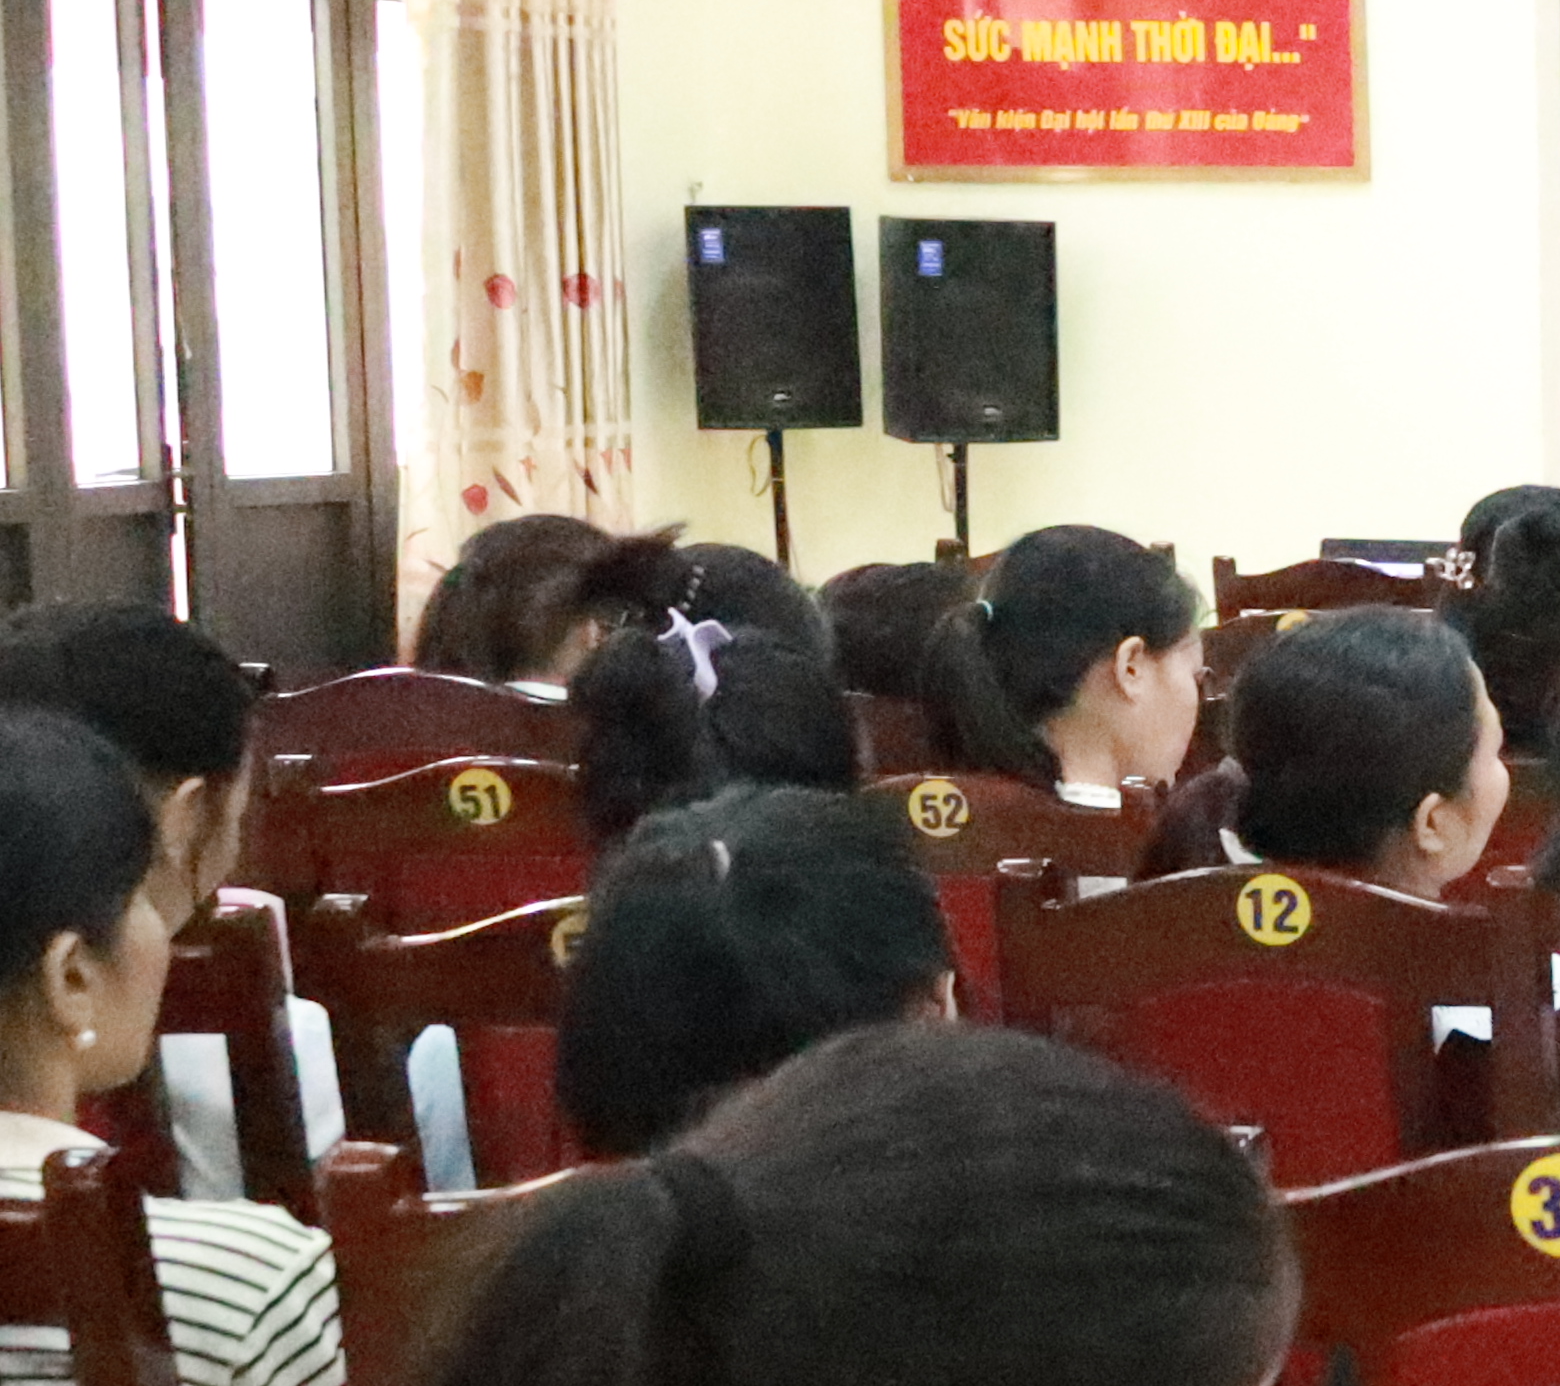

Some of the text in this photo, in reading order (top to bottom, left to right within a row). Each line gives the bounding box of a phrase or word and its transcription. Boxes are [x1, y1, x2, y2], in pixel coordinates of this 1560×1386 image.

[944, 11, 1011, 61] SỨC
[1022, 19, 1122, 69] MẠNH
[1132, 11, 1205, 62] THỜI
[459, 786, 504, 822] 51
[920, 795, 961, 828] 52
[1248, 890, 1299, 933] 12
